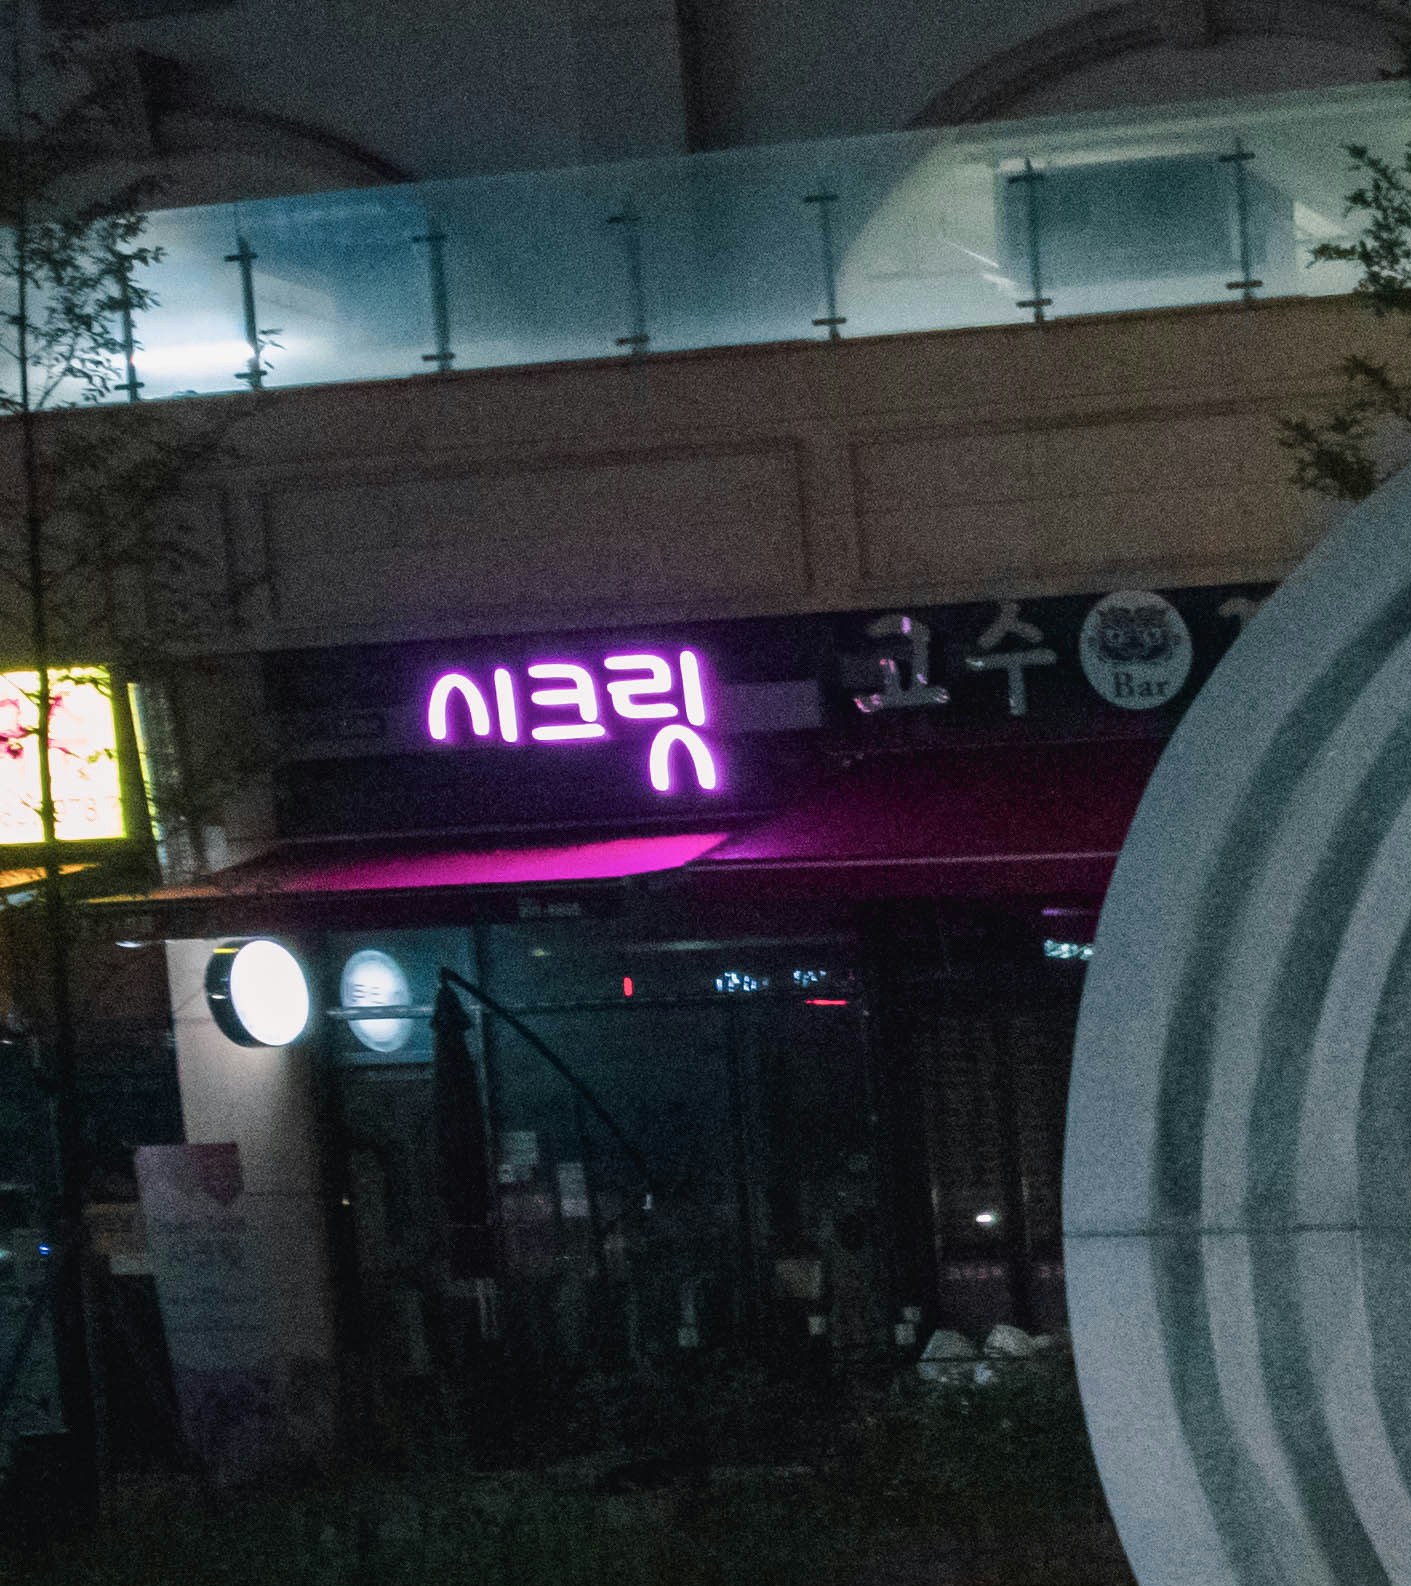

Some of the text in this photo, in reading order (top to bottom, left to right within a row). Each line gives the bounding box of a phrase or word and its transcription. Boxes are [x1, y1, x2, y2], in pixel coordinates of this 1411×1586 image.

[853, 600, 1058, 716] 고수
[1113, 673, 1169, 700] Bar
[427, 648, 717, 792] 시크릿
